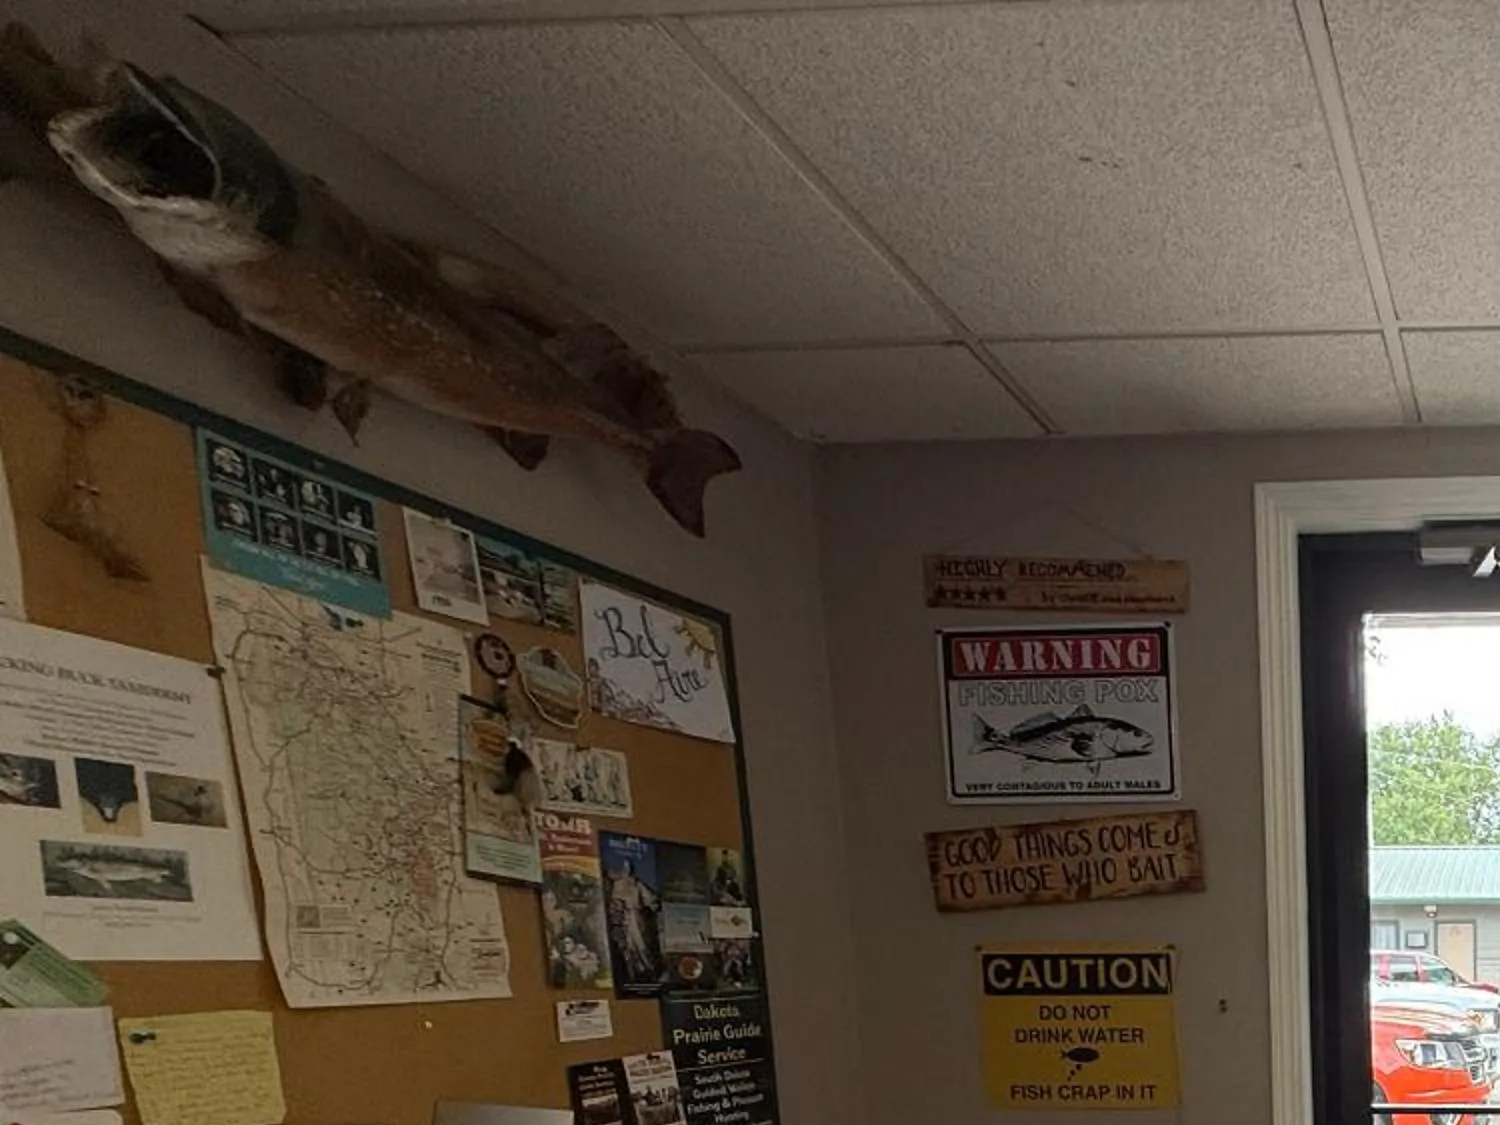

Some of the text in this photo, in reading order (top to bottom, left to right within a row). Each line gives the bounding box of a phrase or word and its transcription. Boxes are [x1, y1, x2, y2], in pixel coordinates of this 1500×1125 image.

[959, 638, 1151, 673] WARNING
[959, 678, 1159, 707] FISHING POX
[966, 780, 1161, 792] VERY CONTAGIOUS TO ADULT MALES
[944, 832, 1002, 867] GOOD
[1013, 828, 1093, 860] THINGS
[943, 853, 1179, 900] TO THOSE WHO BAIT
[987, 958, 1168, 989] CAUTION
[1039, 1004, 1112, 1020] DO NOT
[723, 1023, 762, 1041] Guide
[1014, 1027, 1144, 1043] DRINK WATER
[697, 1046, 747, 1065] Service
[1009, 1083, 1157, 1100] FISH CRAP IN IT
